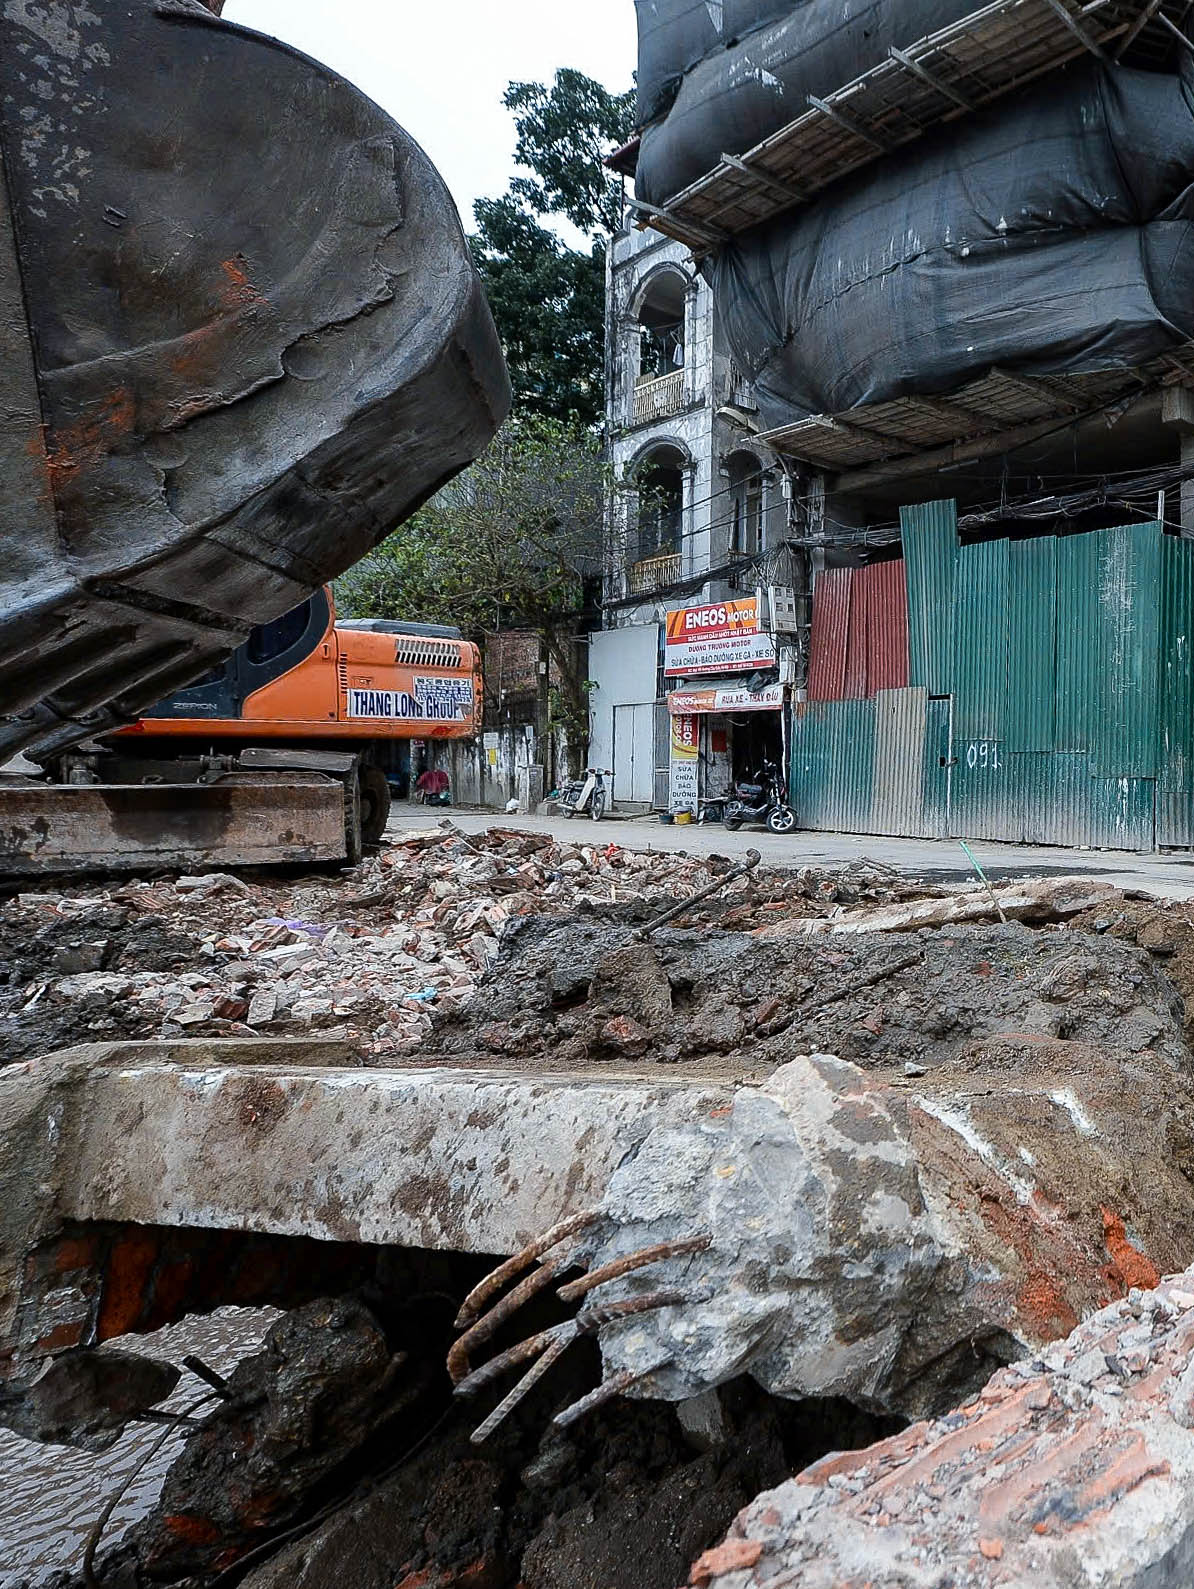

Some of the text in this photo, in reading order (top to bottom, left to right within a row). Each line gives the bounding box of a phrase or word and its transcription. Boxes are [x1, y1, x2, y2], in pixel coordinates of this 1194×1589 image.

[685, 607, 726, 630] ENEOS
[727, 608, 754, 623] MOTOR
[353, 691, 391, 717] THANG
